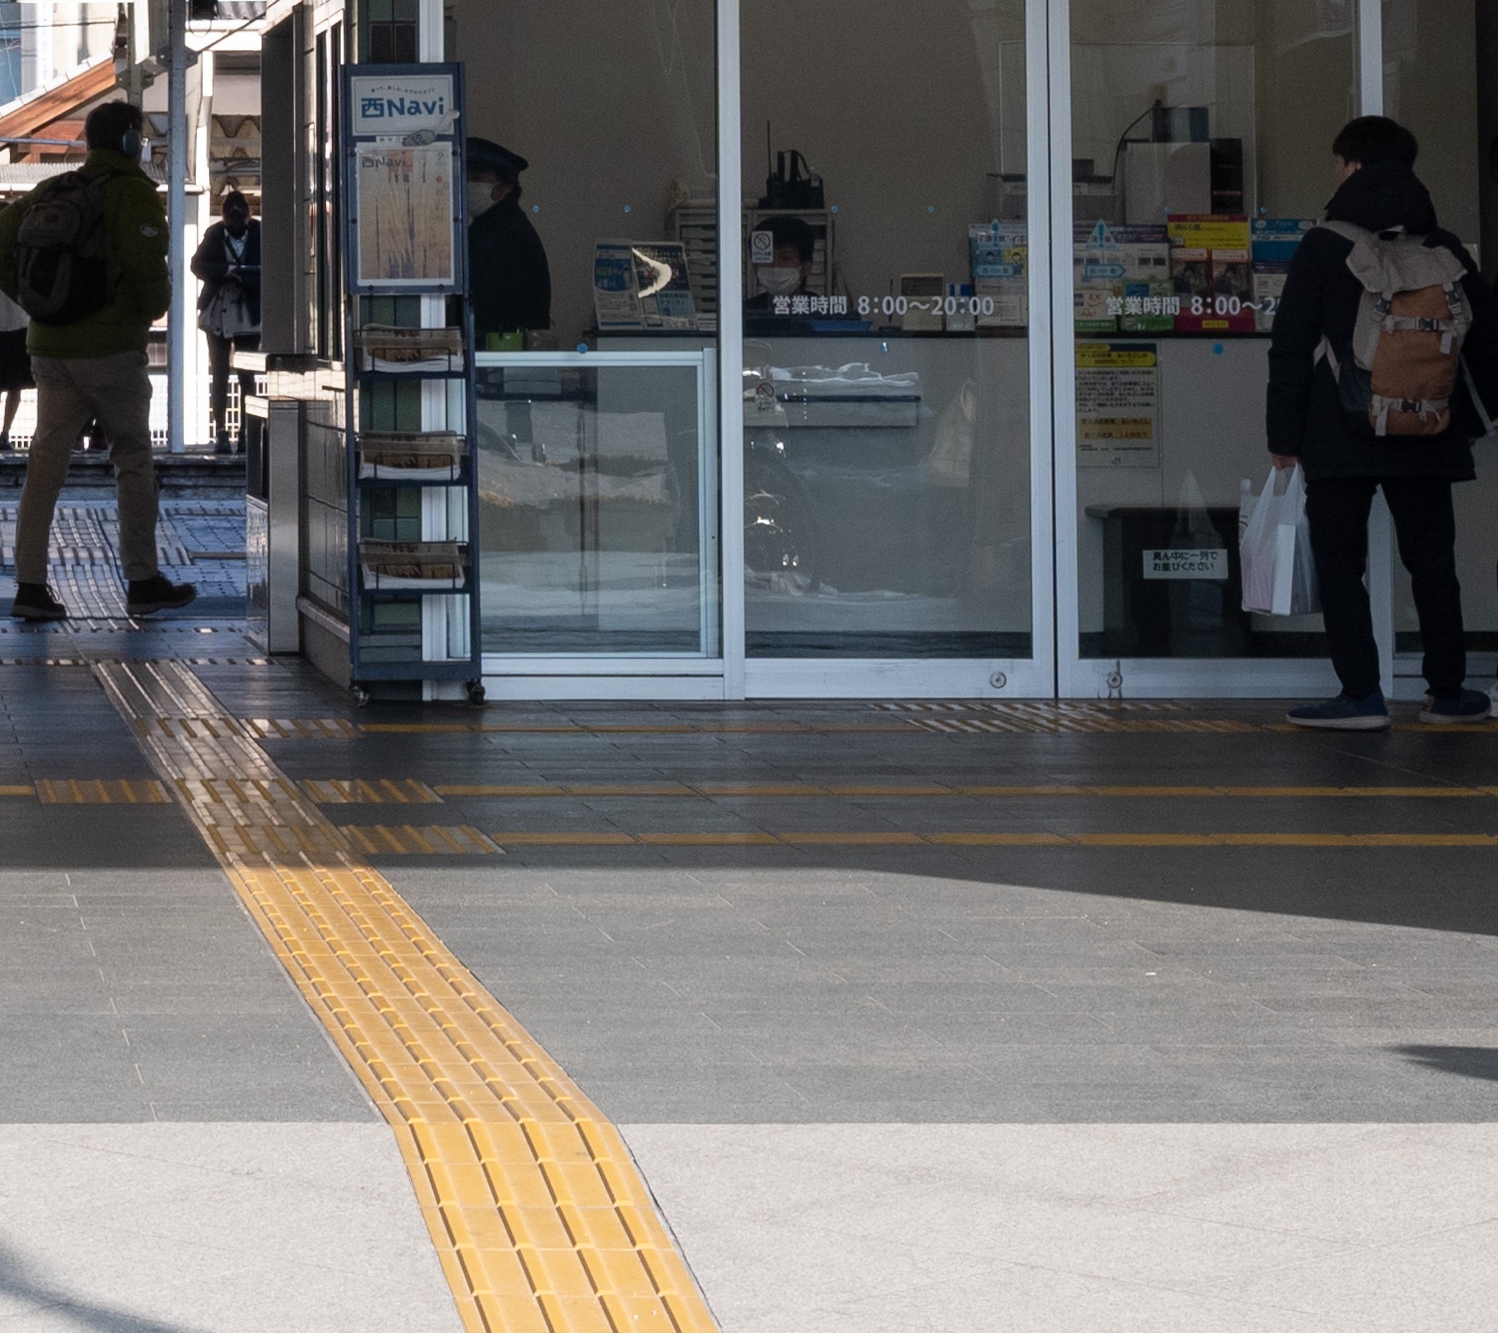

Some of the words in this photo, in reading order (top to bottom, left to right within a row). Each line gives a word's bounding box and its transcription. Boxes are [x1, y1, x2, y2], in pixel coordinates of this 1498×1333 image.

[361, 97, 445, 119] 西Navi
[772, 294, 848, 316] 営業時間
[1105, 294, 1182, 316] 営業時間
[1190, 296, 1281, 317] 8:00〜2
